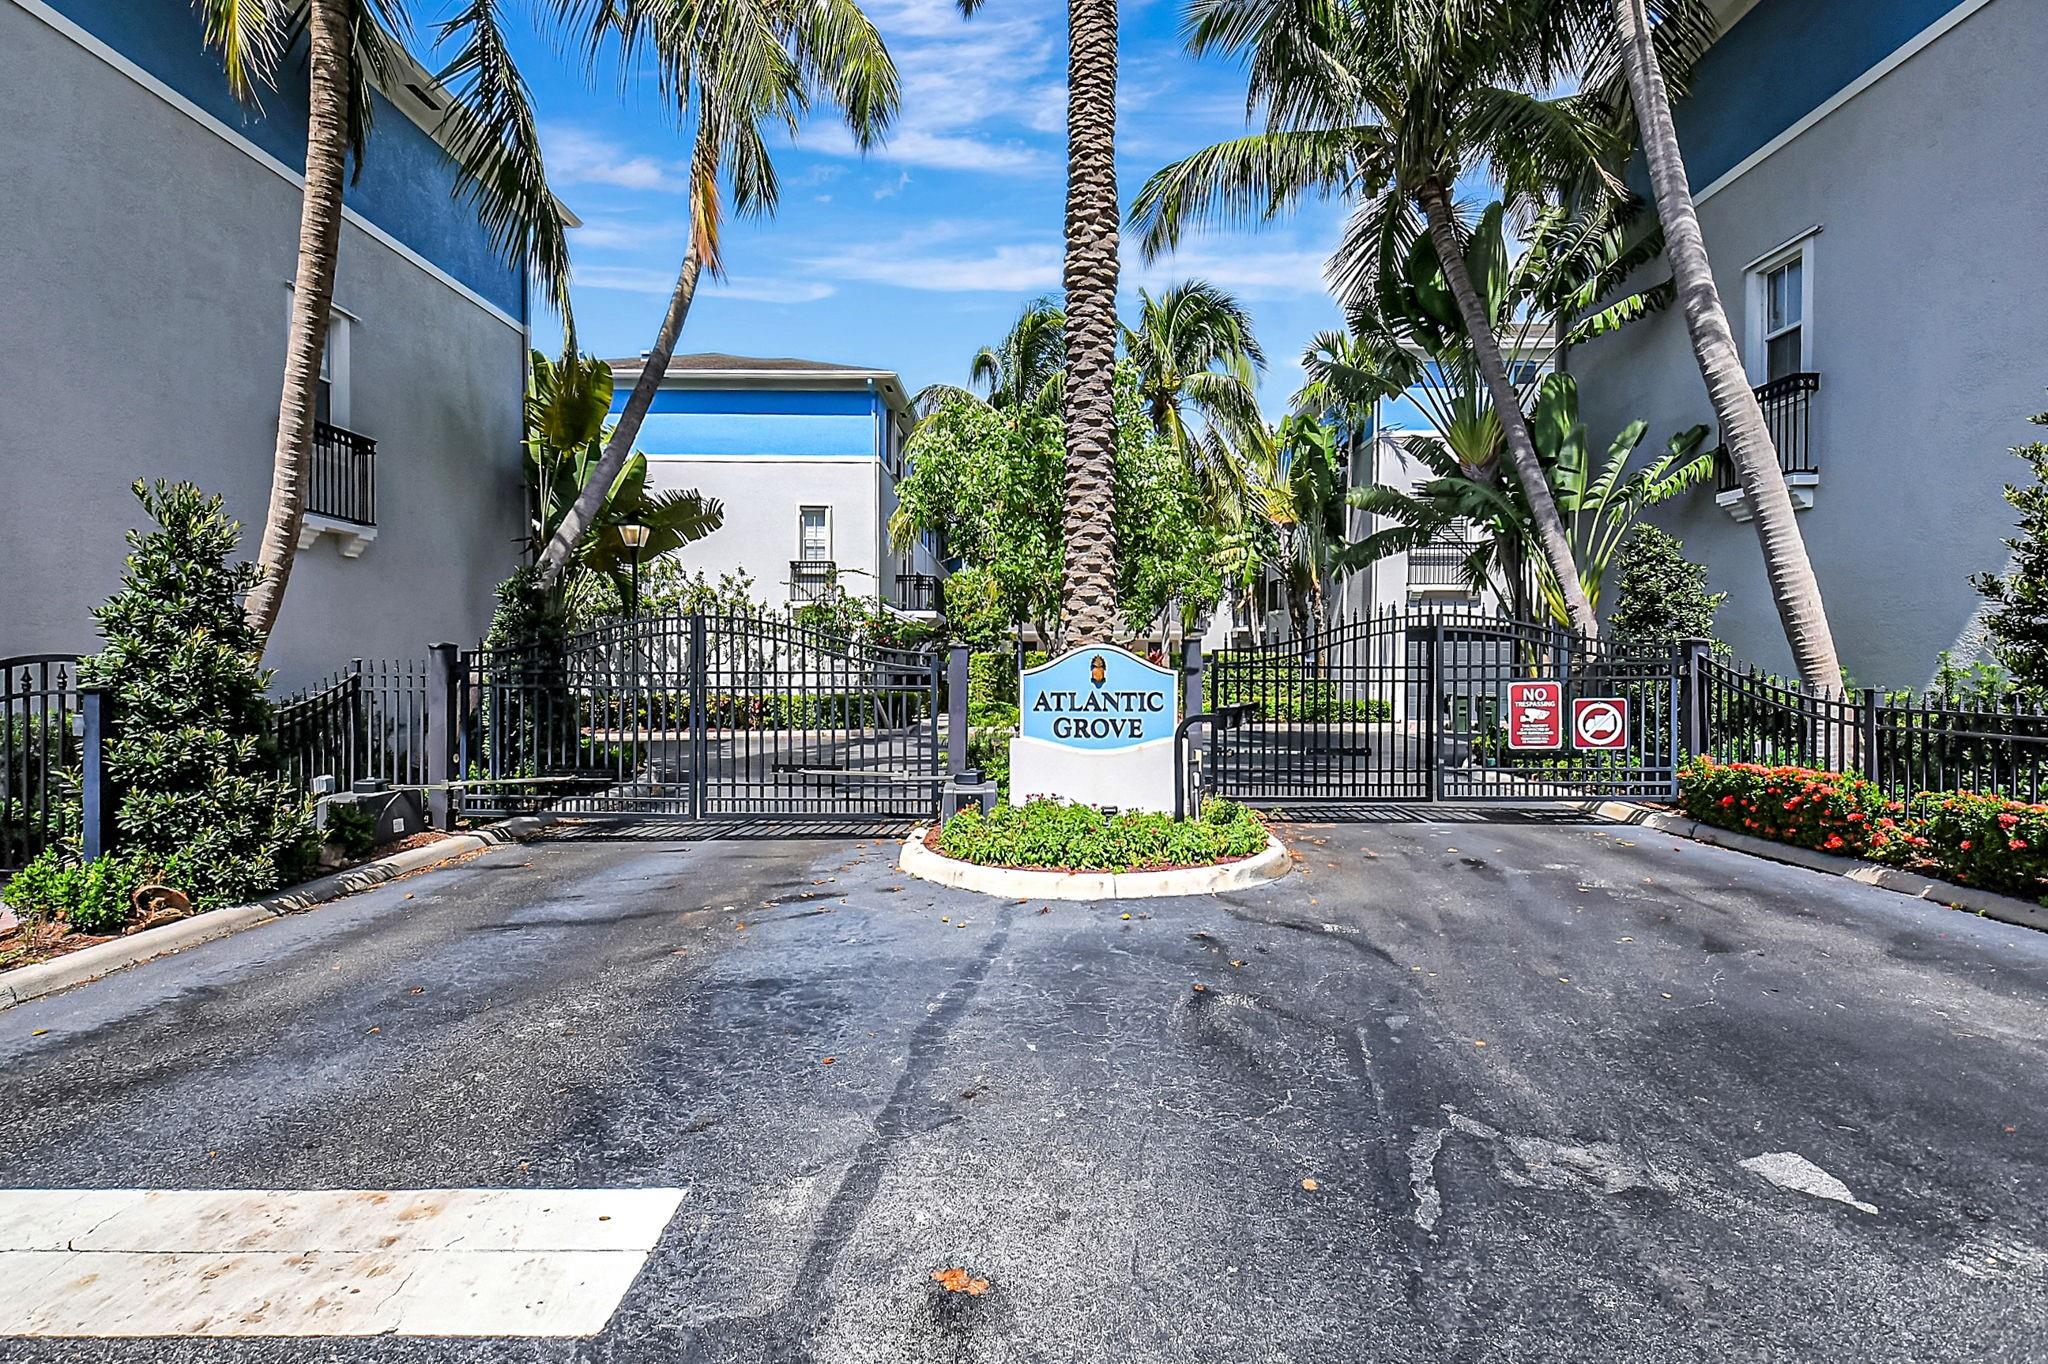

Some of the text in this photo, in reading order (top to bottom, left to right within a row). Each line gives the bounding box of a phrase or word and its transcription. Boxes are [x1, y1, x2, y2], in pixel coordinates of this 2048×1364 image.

[1033, 690, 1164, 712] ATLANTIC
[1523, 688, 1548, 701] NO
[1053, 717, 1144, 738] GROVE
